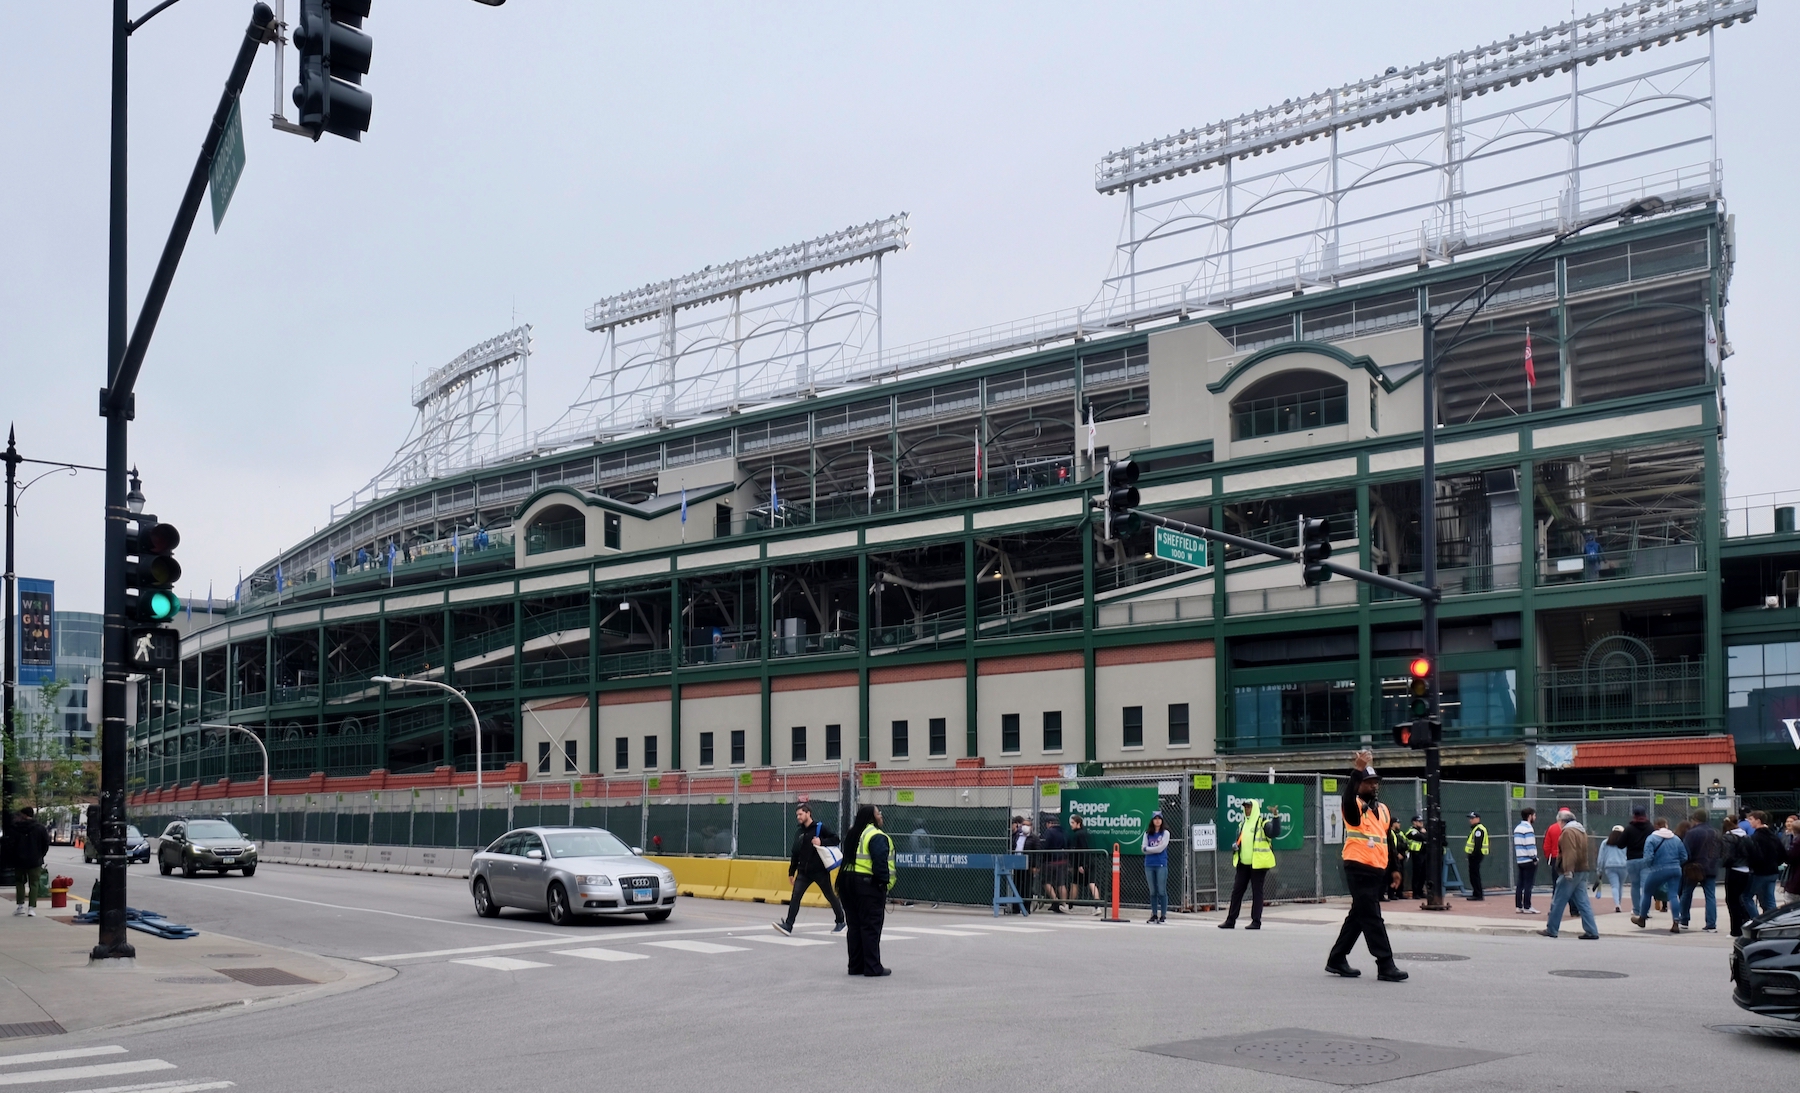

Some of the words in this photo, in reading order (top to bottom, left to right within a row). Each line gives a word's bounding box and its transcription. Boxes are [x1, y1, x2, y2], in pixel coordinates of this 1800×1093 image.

[1158, 533, 1162, 542] N
[1163, 532, 1198, 552] SHEFFIELD
[1198, 543, 1205, 552] AV
[1171, 548, 1186, 560] 1000
[1187, 552, 1193, 562] W
[1069, 800, 1110, 815] Pepper
[1069, 814, 1141, 827] Cnstruction
[1194, 828, 1215, 836] SIDEWALK
[1196, 839, 1213, 847] CLOSED
[896, 854, 913, 863] POLICE
[940, 854, 949, 864] NOT
[950, 855, 968, 865] CROSS
